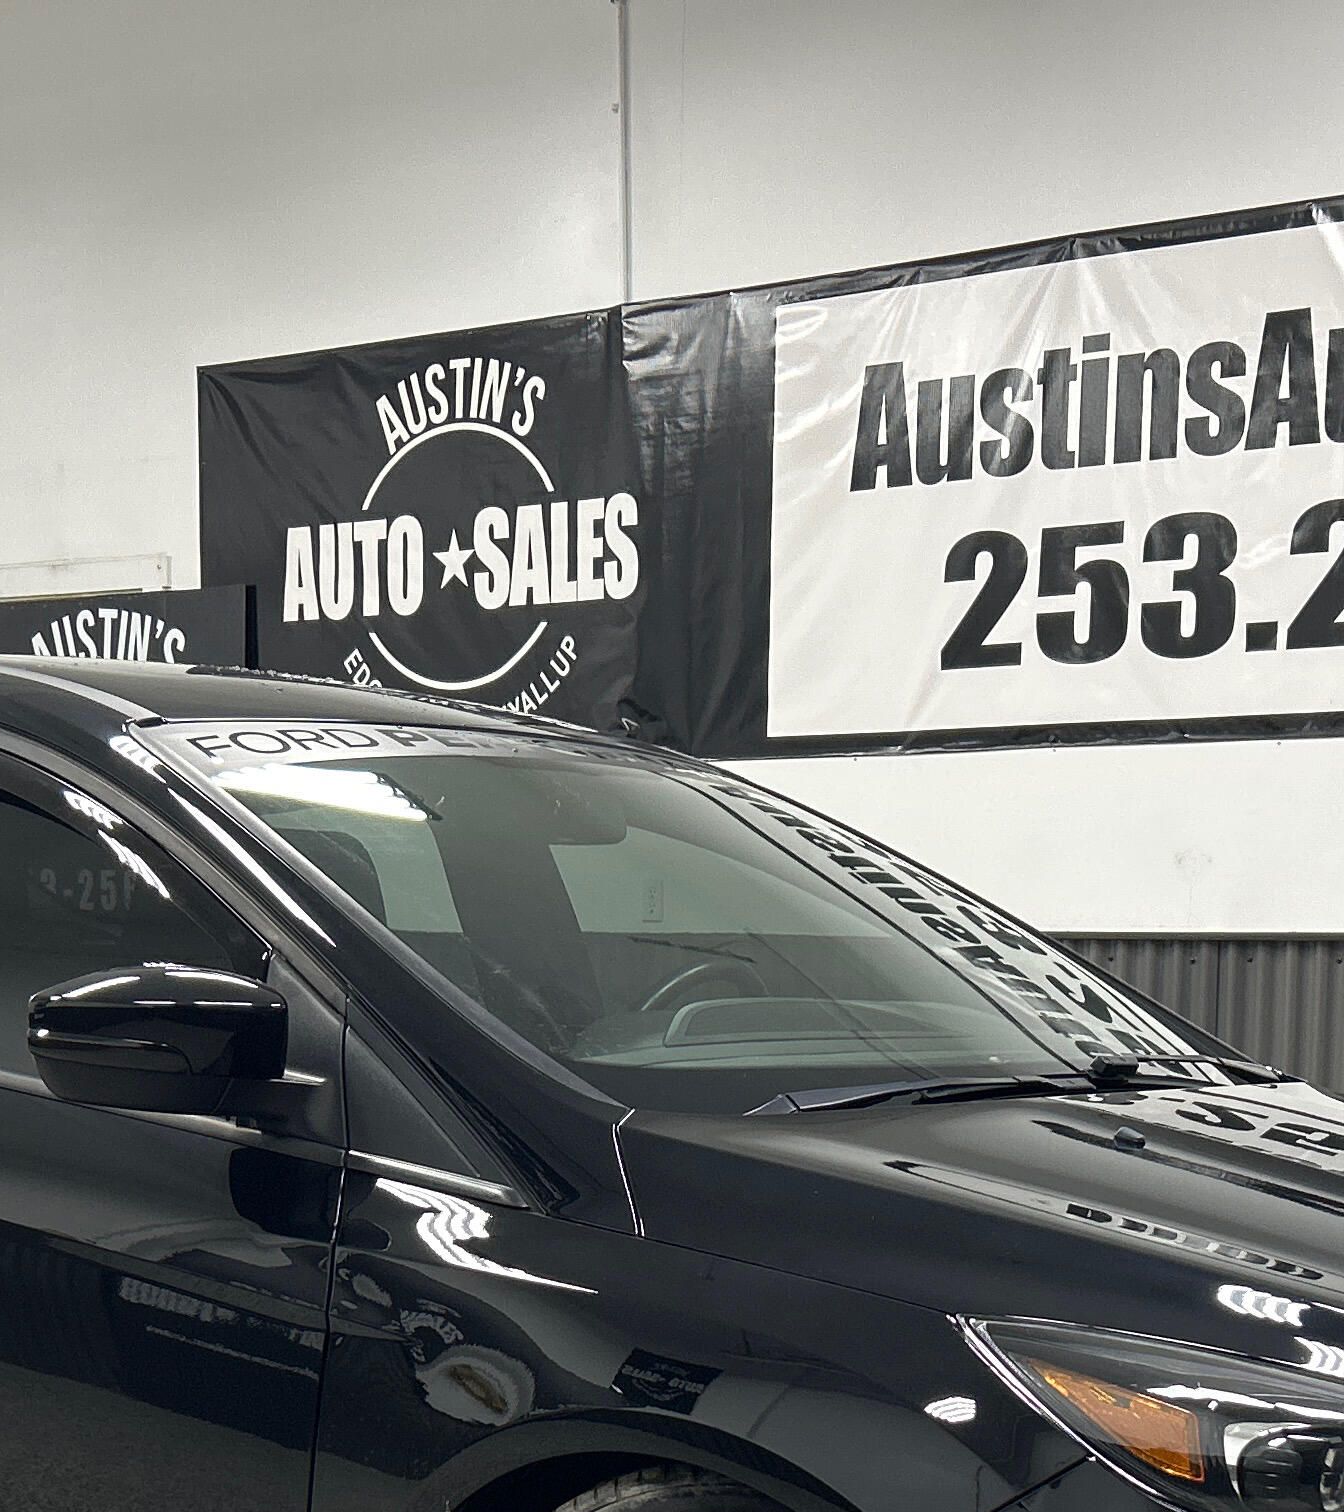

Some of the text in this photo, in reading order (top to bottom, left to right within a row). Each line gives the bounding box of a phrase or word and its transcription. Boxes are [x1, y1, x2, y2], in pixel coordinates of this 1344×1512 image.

[375, 357, 546, 456] AUSTIN'S
[283, 493, 640, 623] AUTO SALES
[185, 728, 380, 760] FORD
